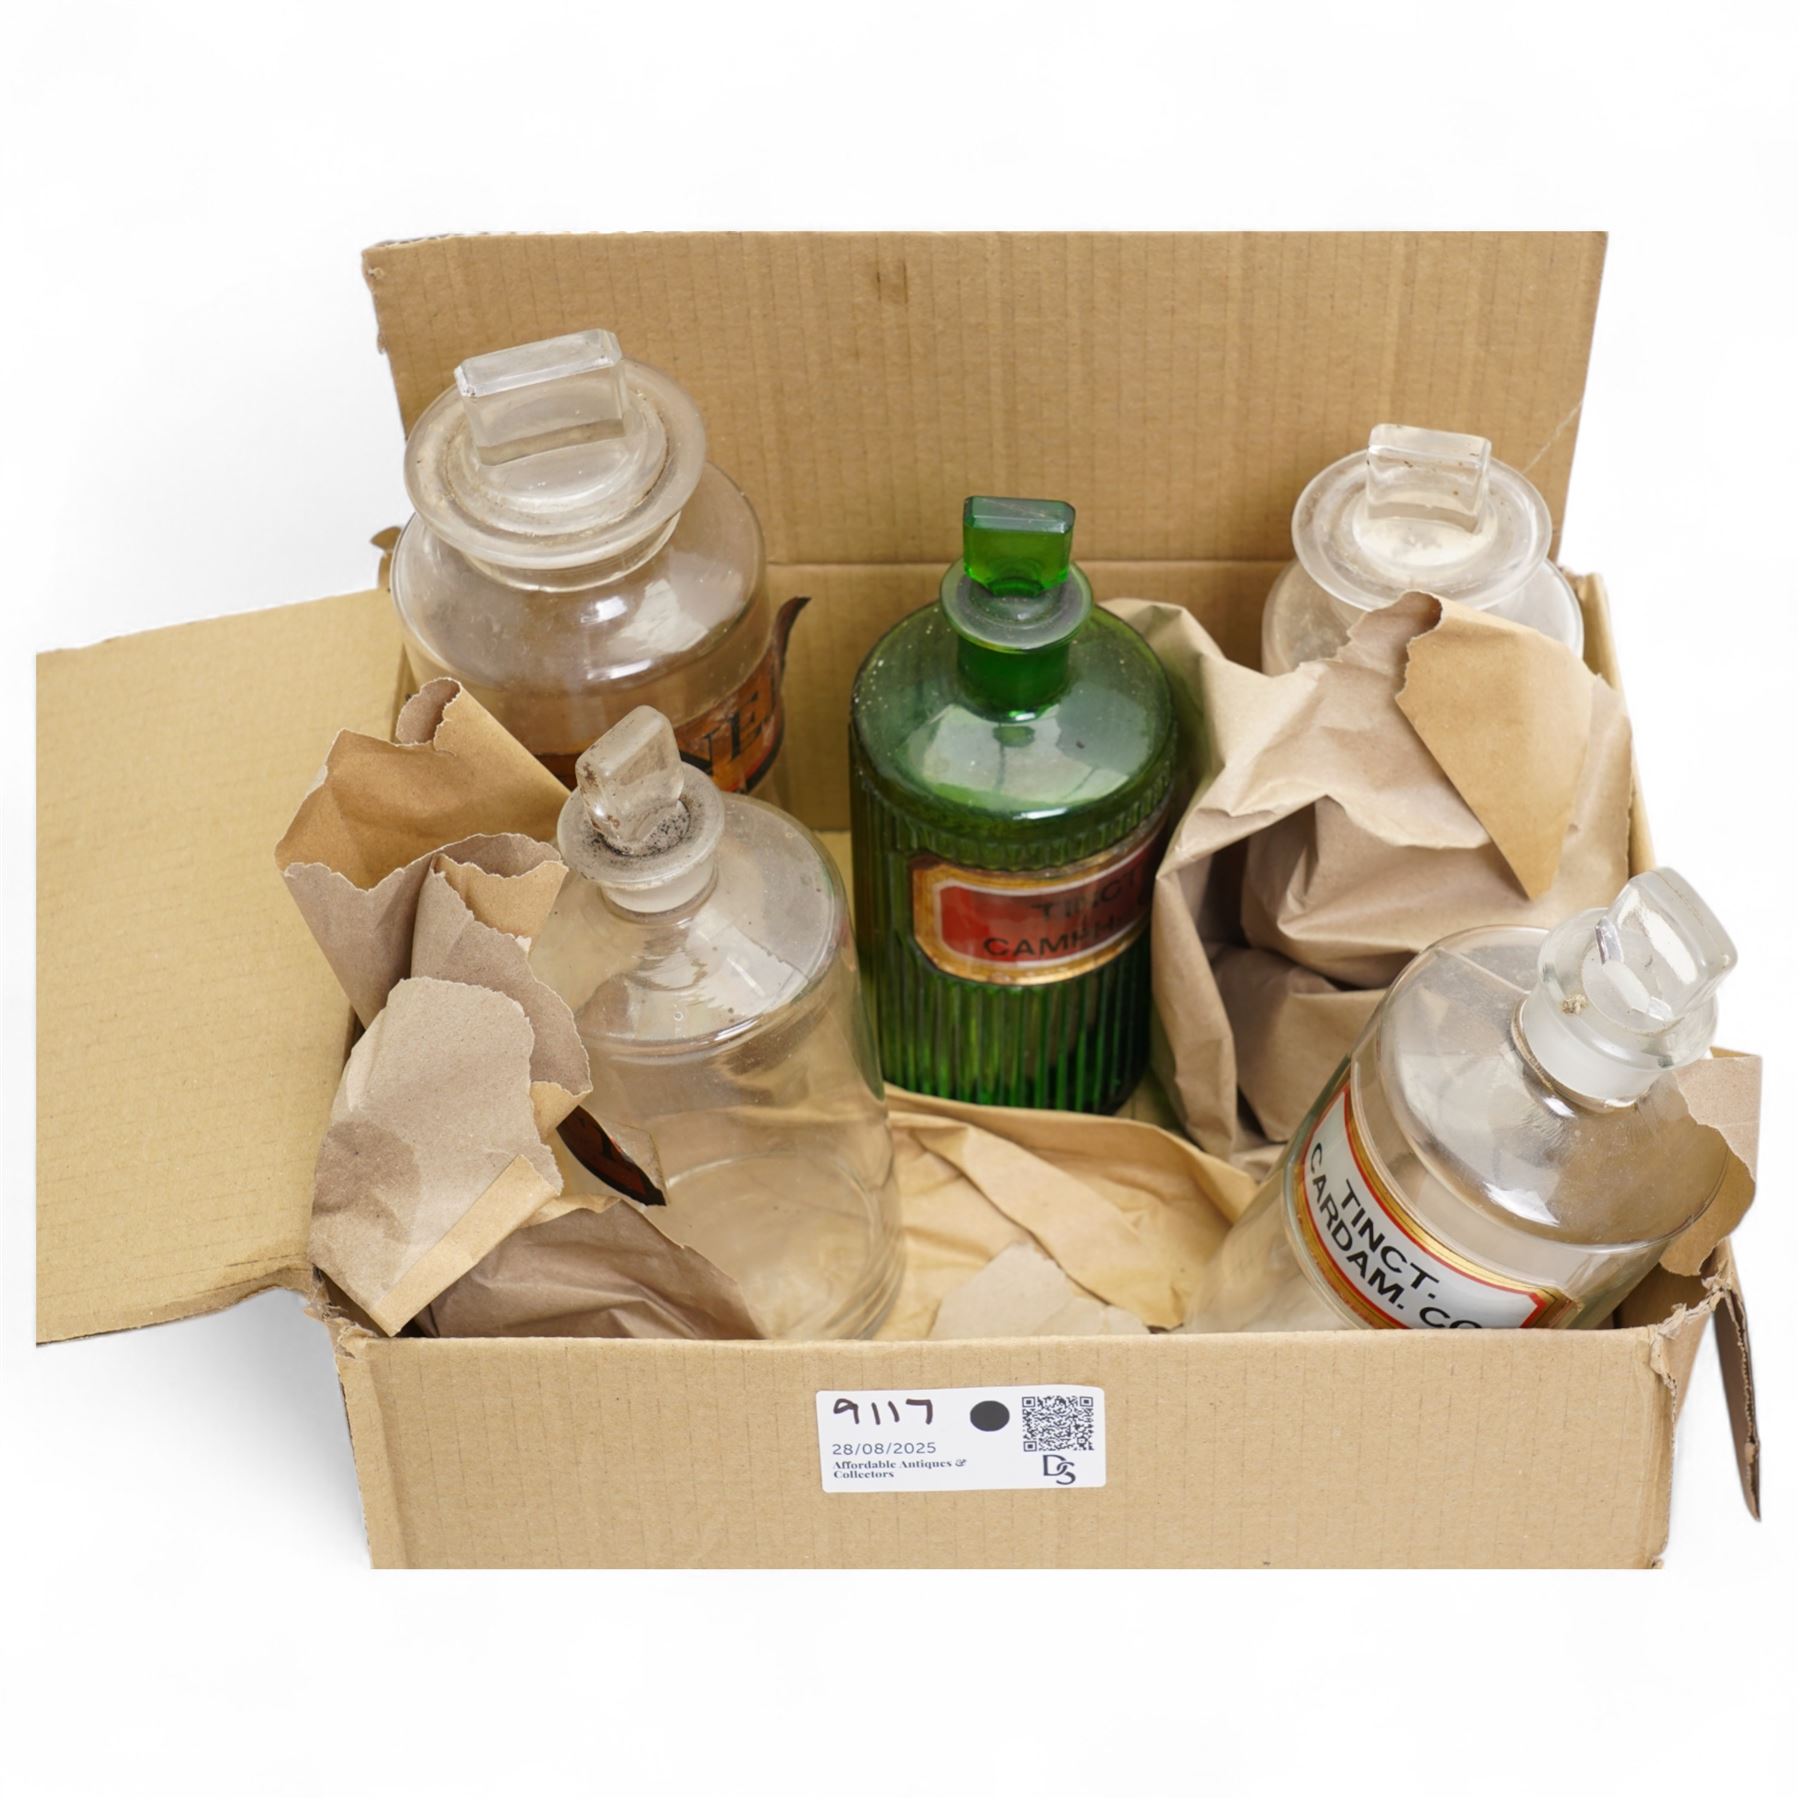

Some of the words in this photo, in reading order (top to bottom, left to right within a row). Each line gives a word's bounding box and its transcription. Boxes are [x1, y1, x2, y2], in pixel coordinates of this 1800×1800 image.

[1310, 1142, 1405, 1310] CARDAM.
[1339, 1179, 1439, 1300] TINCT.
[833, 1398, 933, 1425] 9117
[832, 1442, 937, 1456] 28/08/2025
[833, 1459, 896, 1470] Affordable
[900, 1458, 952, 1469] Antiques
[955, 1458, 967, 1468] &
[833, 1470, 895, 1479] Collectors
